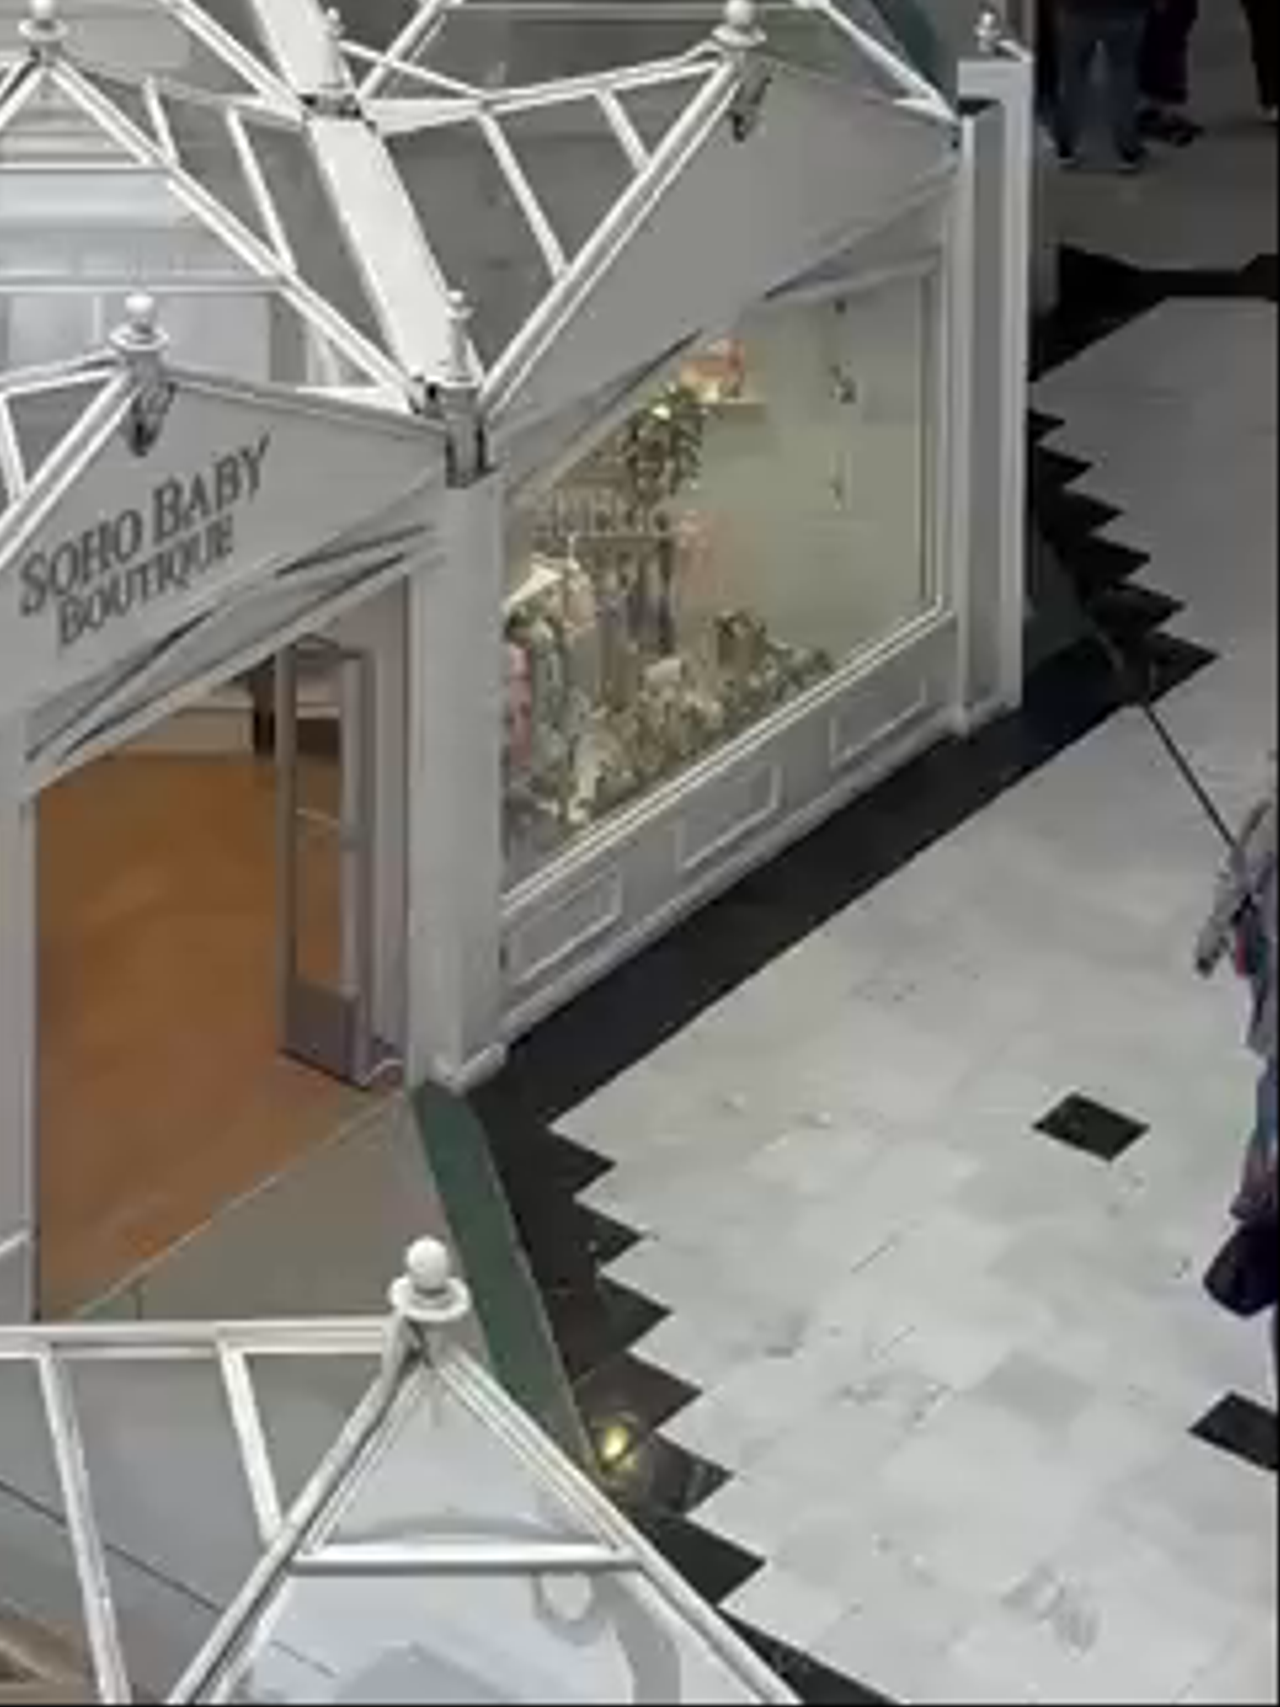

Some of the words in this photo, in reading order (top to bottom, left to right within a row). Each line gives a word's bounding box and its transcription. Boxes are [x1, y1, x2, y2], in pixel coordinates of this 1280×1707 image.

[19, 508, 143, 617] SOHO
[152, 431, 270, 544] BABY
[60, 512, 234, 646] BOUTIQUE
